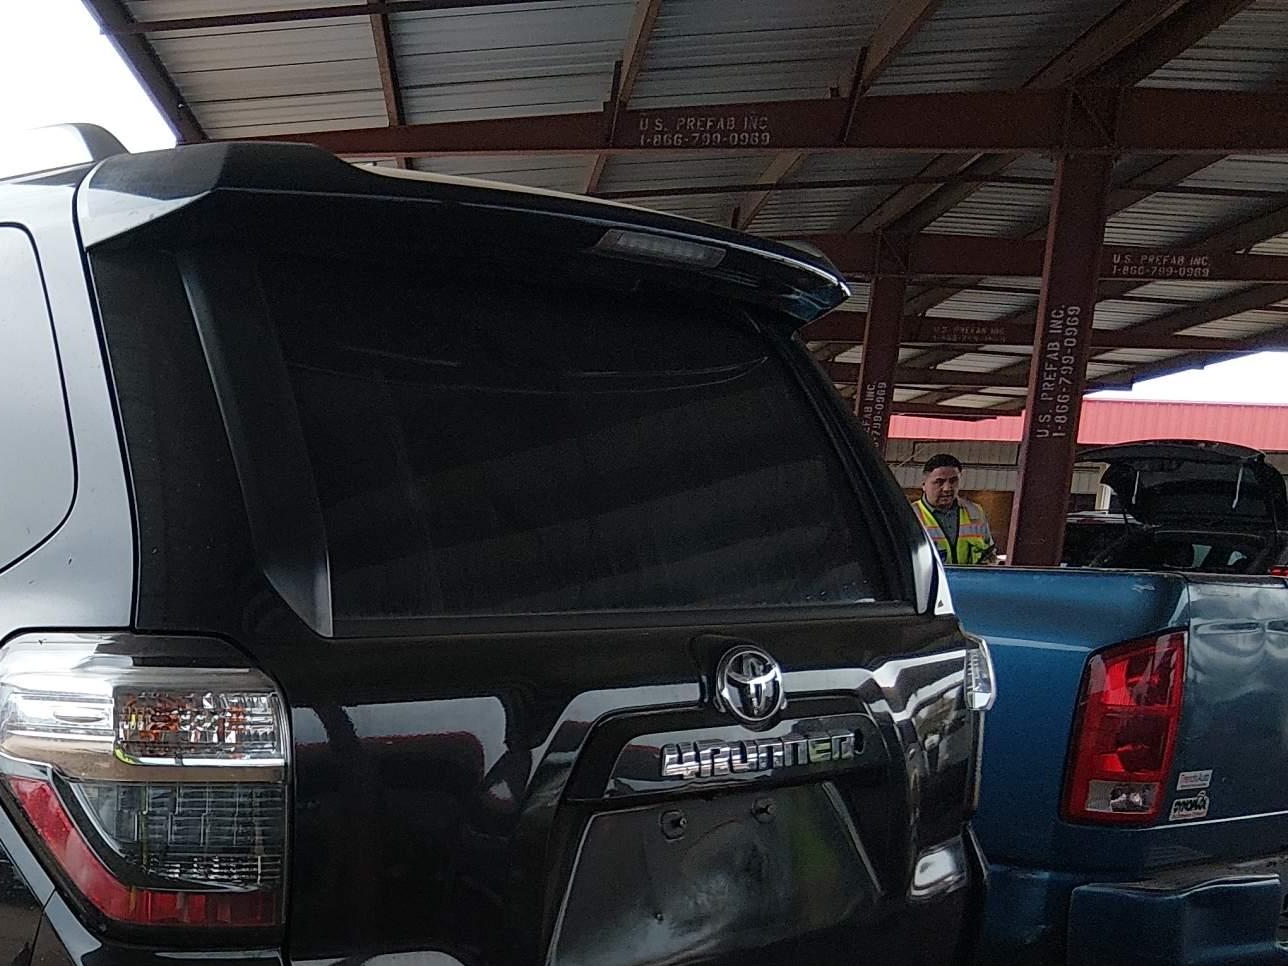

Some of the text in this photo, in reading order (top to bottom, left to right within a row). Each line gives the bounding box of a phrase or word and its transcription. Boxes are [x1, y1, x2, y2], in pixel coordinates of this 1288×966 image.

[676, 116, 735, 130] PREFAB
[1140, 254, 1185, 266] PREFAB
[1036, 304, 1065, 439] U.S. PREFAB INC.
[1052, 305, 1081, 438] 1-866-799-0969
[663, 730, 855, 779] 4RUNNER
